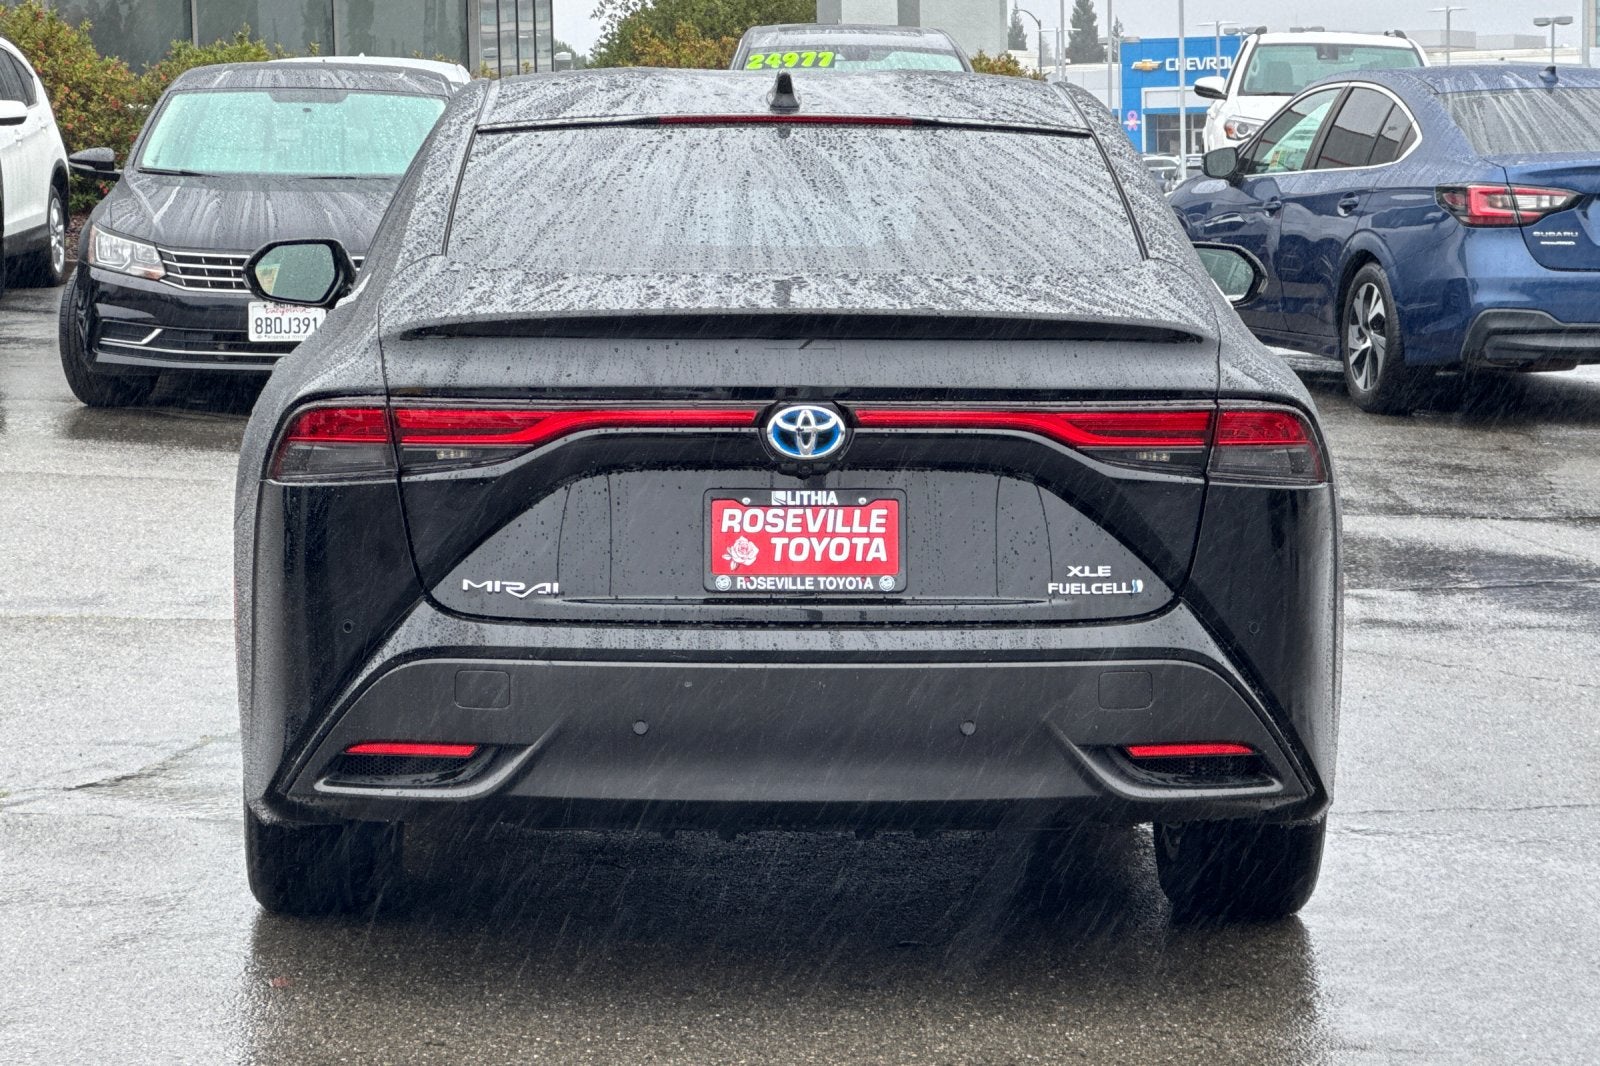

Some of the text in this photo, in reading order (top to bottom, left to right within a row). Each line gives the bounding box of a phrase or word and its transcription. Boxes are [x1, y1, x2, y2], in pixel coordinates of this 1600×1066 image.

[746, 51, 835, 70] 24977
[786, 490, 839, 506] LITHIA
[720, 508, 888, 533] ROSEVILLE
[770, 537, 888, 562] TOYOTA
[1066, 565, 1112, 577] XLE
[462, 579, 559, 598] MIRAI
[736, 576, 874, 590] ROSEVILLE TOYOTA
[1047, 582, 1132, 594] FUELCELL
